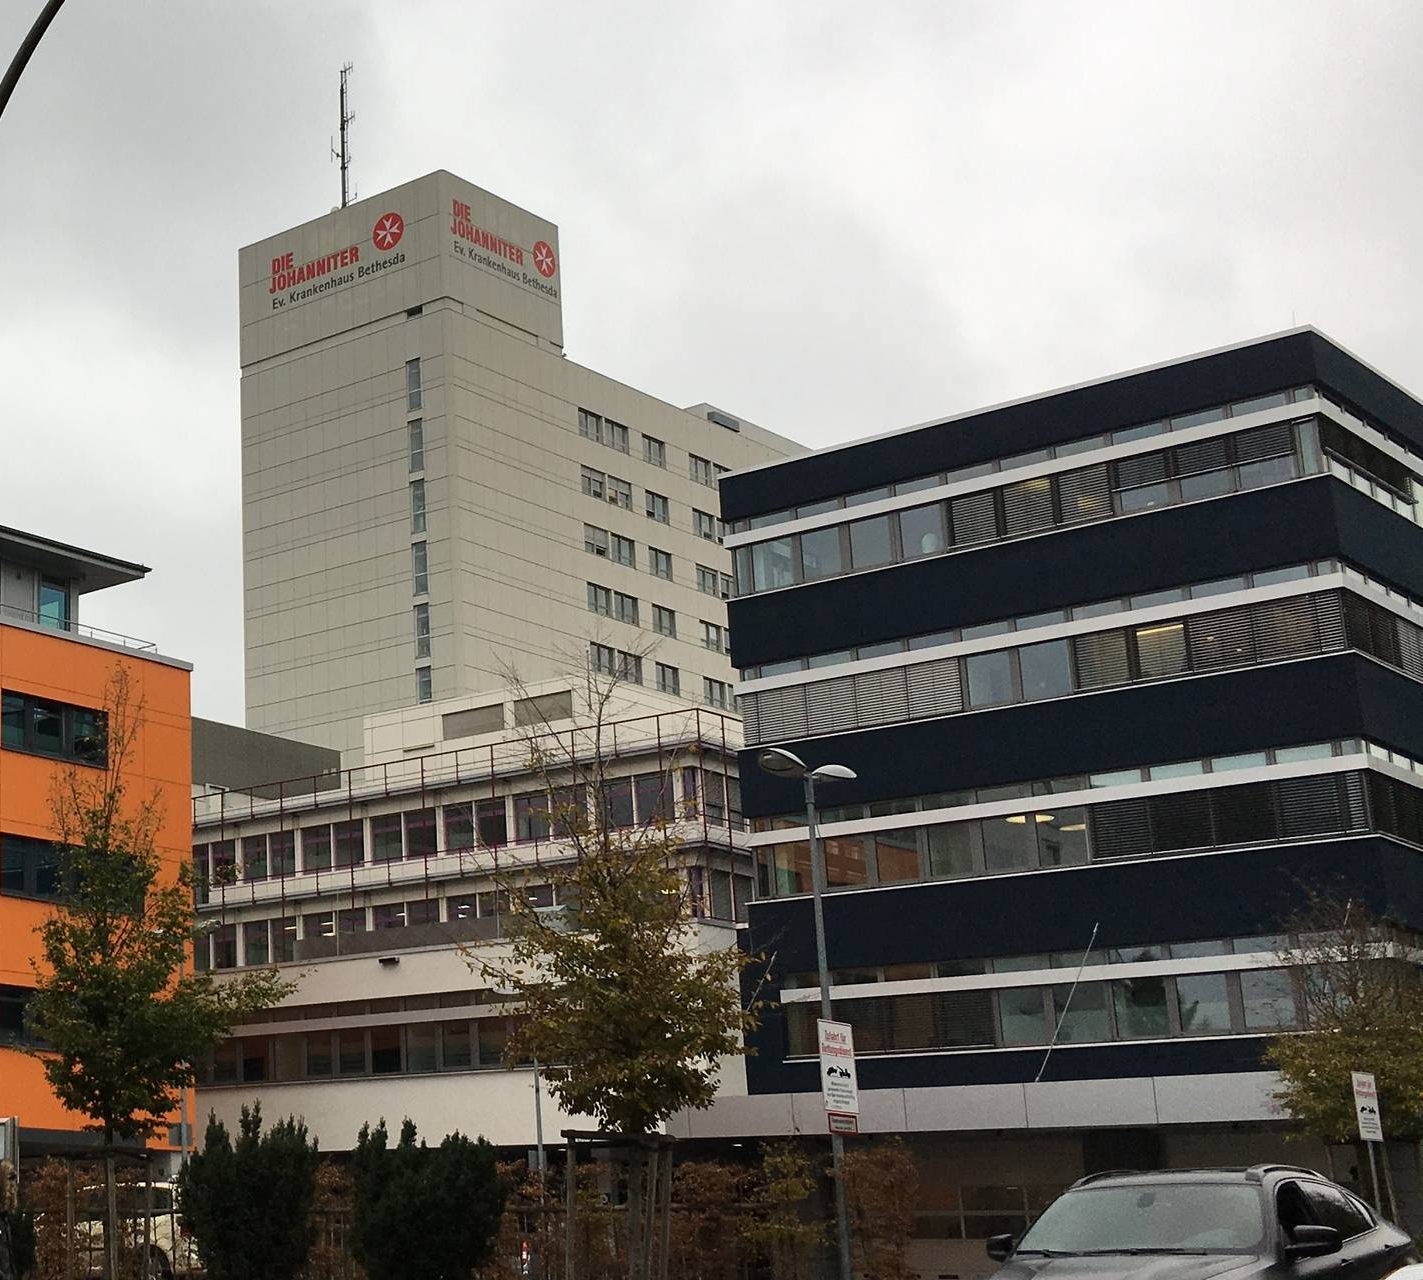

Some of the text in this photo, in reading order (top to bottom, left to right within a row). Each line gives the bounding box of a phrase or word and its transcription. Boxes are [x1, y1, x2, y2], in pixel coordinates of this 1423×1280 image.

[453, 199, 471, 223] DIE
[272, 251, 294, 275] DIE
[451, 218, 523, 266] JOHANNITER
[269, 246, 359, 294] JOHANNITER
[272, 253, 405, 310] Ev. Krankenhaus Bethesda
[454, 241, 558, 299] Ev. Krankenhaus Bethesda
